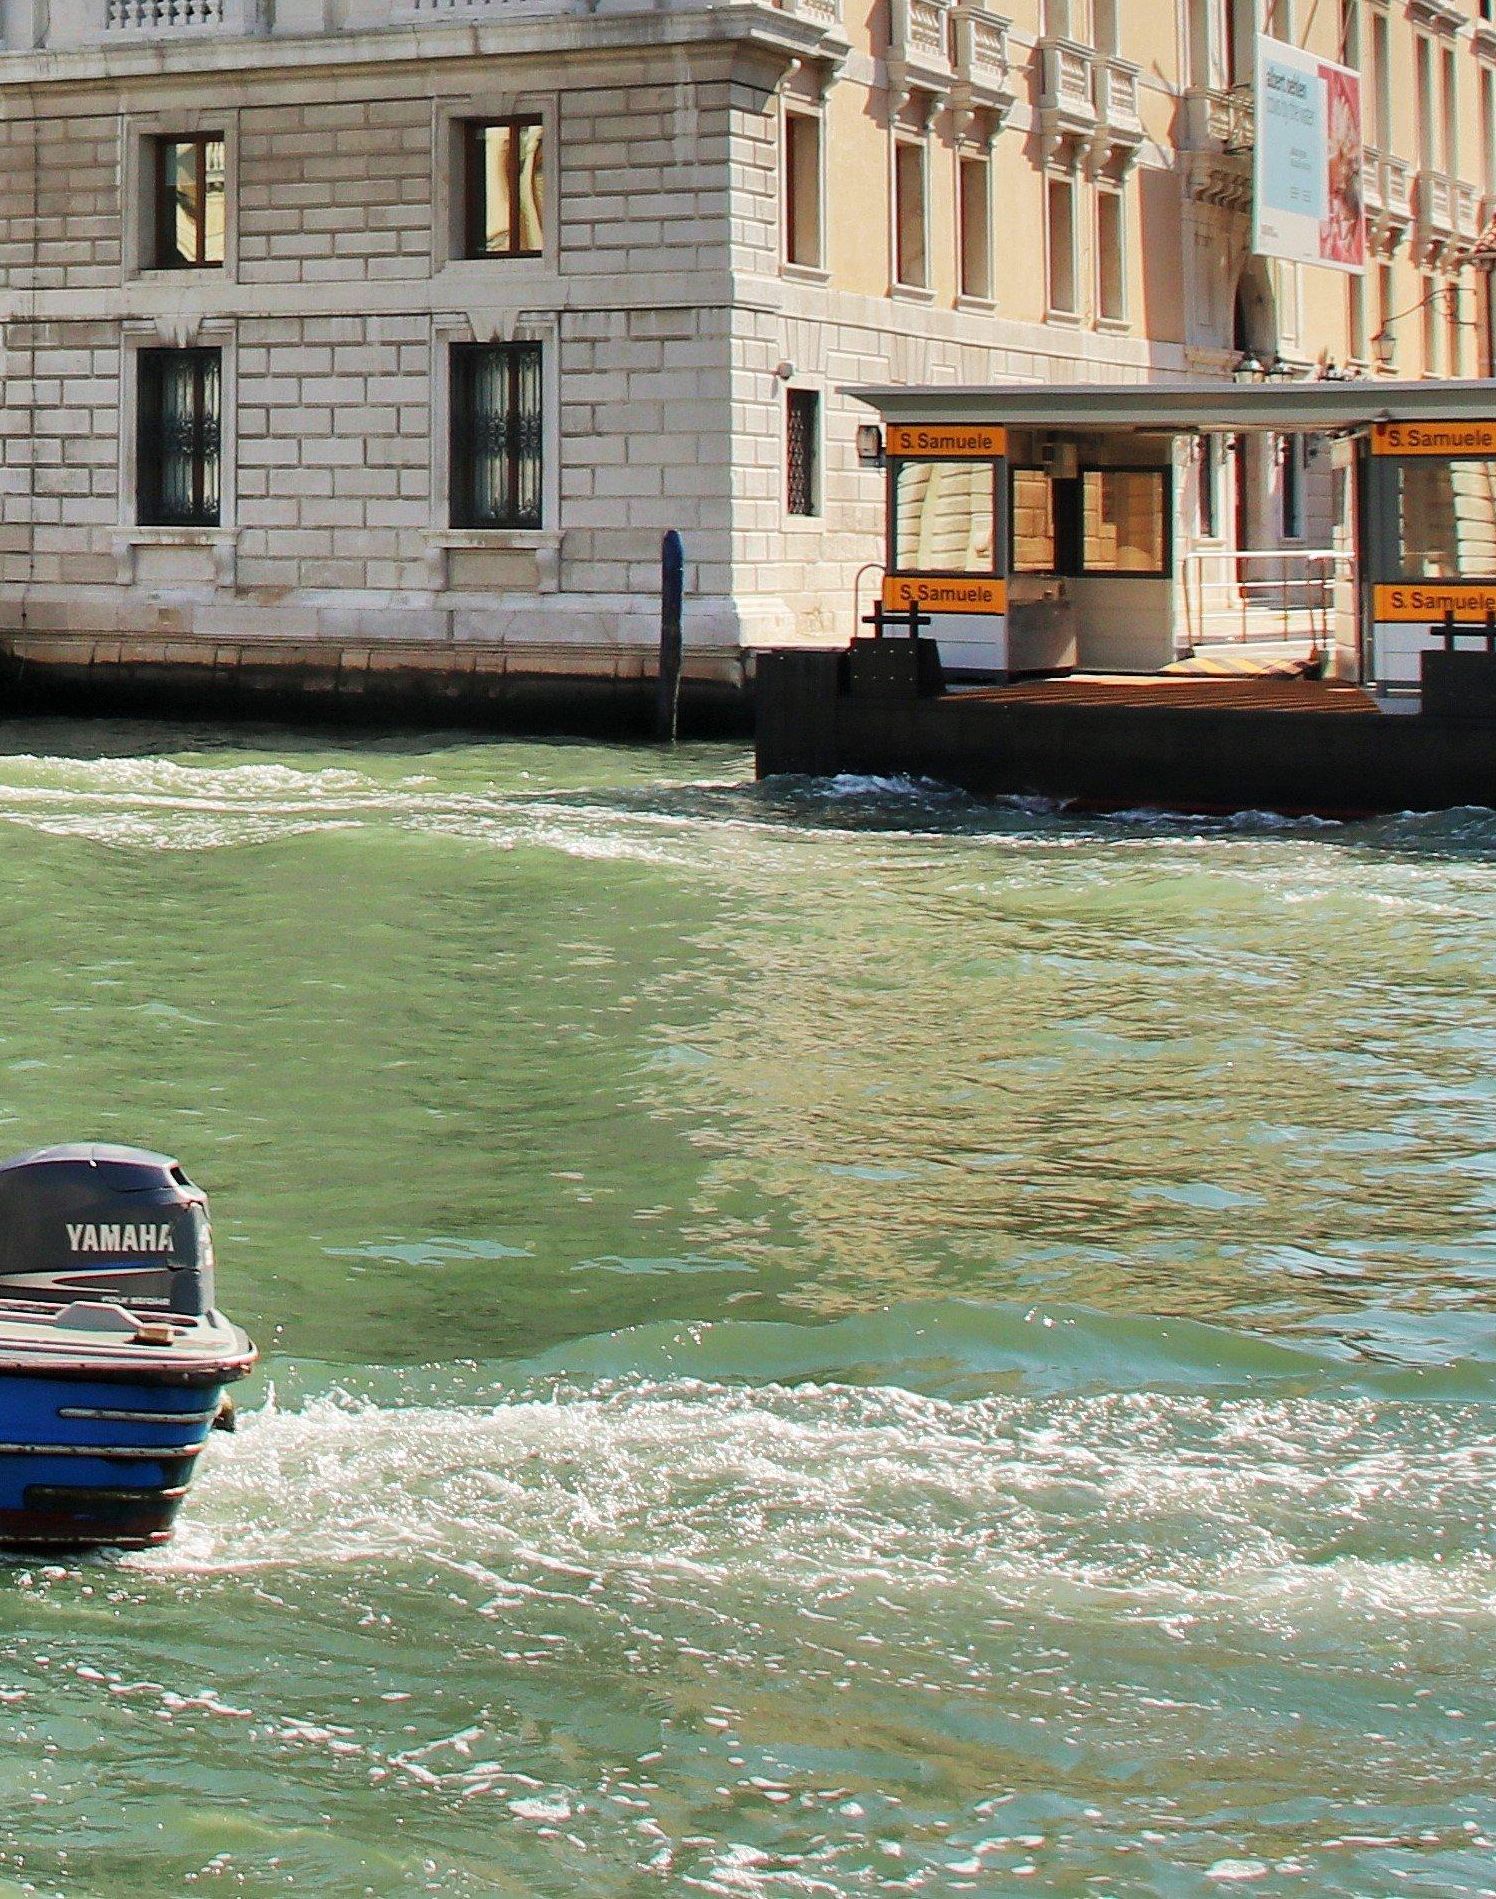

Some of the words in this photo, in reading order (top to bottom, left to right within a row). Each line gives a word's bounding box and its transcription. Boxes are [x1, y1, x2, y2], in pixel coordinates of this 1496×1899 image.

[917, 432, 993, 449] Samuele
[1407, 429, 1493, 447] Samuele
[917, 584, 993, 602] Samuele
[1411, 592, 1496, 611] Samuele
[65, 1222, 175, 1252] YAMAHA
